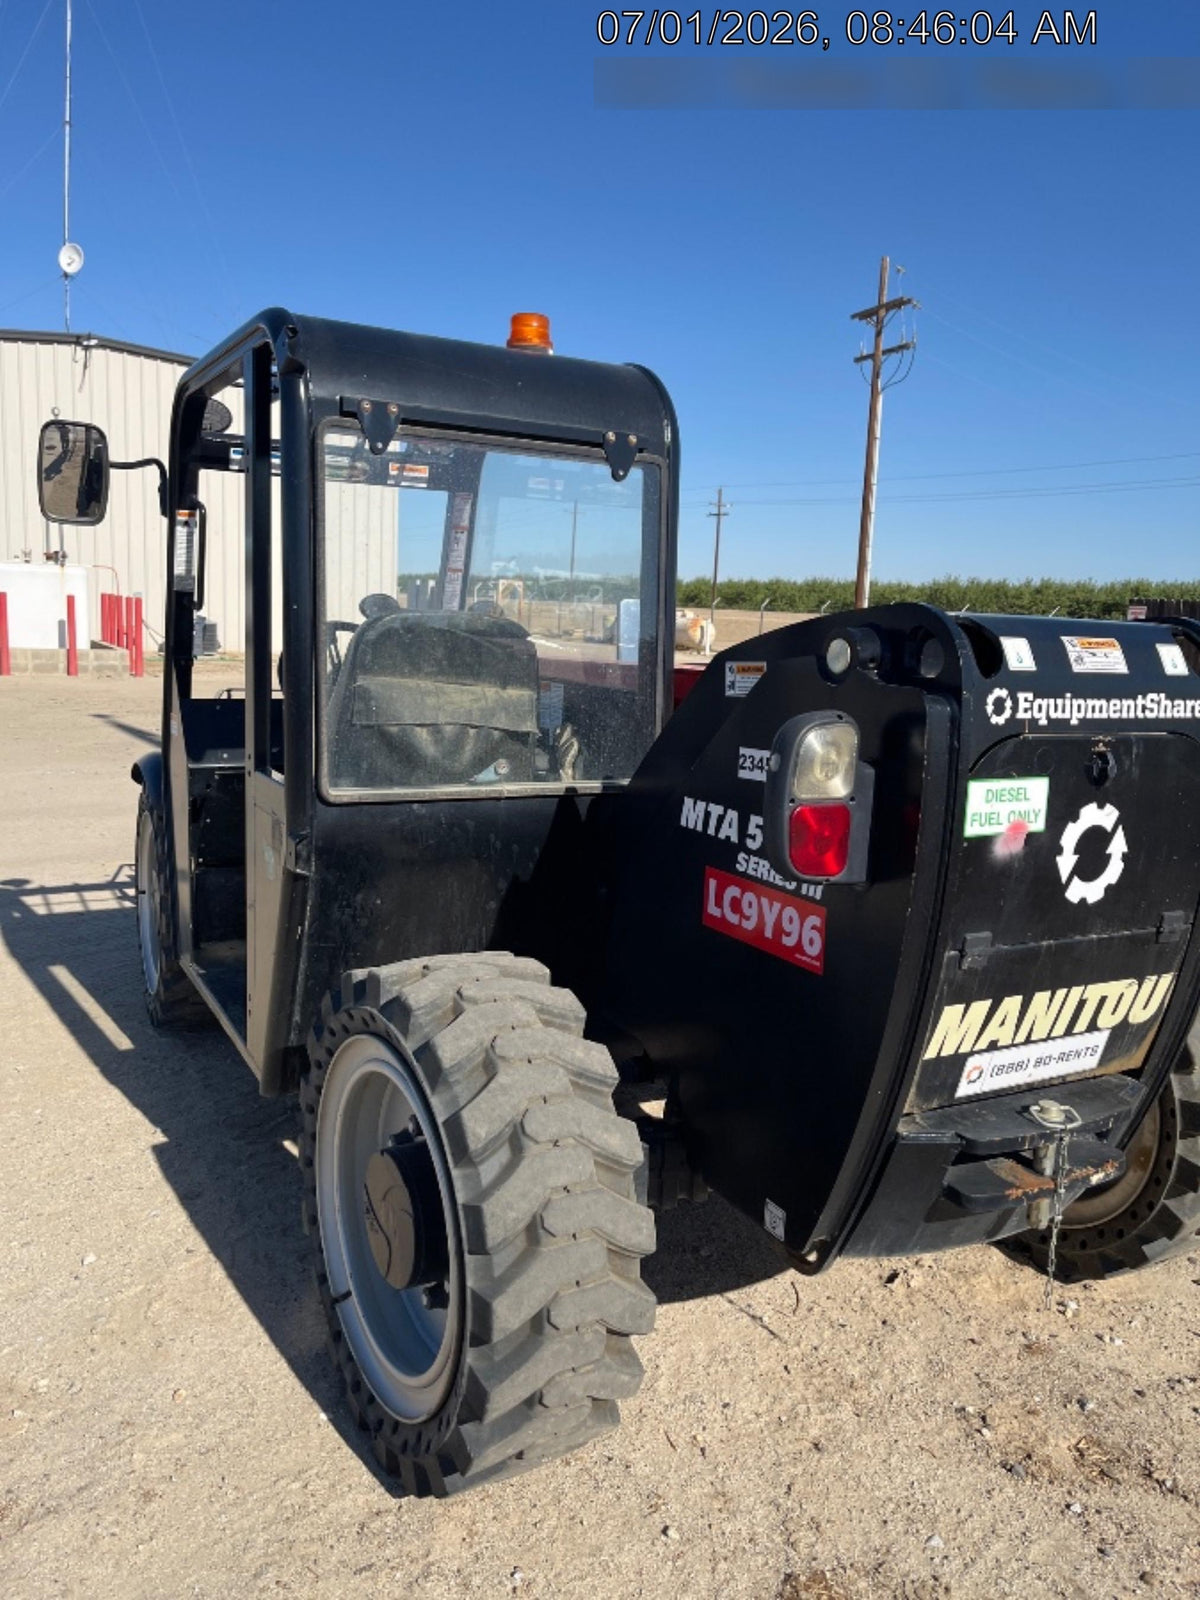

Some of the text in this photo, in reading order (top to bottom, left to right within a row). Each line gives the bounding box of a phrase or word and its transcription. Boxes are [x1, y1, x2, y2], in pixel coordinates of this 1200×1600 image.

[985, 786, 1031, 804] DIESEL
[680, 796, 739, 843] MTA
[970, 808, 1042, 828] FUEL ONLY
[707, 877, 823, 957] LC9Y96
[922, 972, 1175, 1060] MANITOU
[989, 1058, 1031, 1078] (888)
